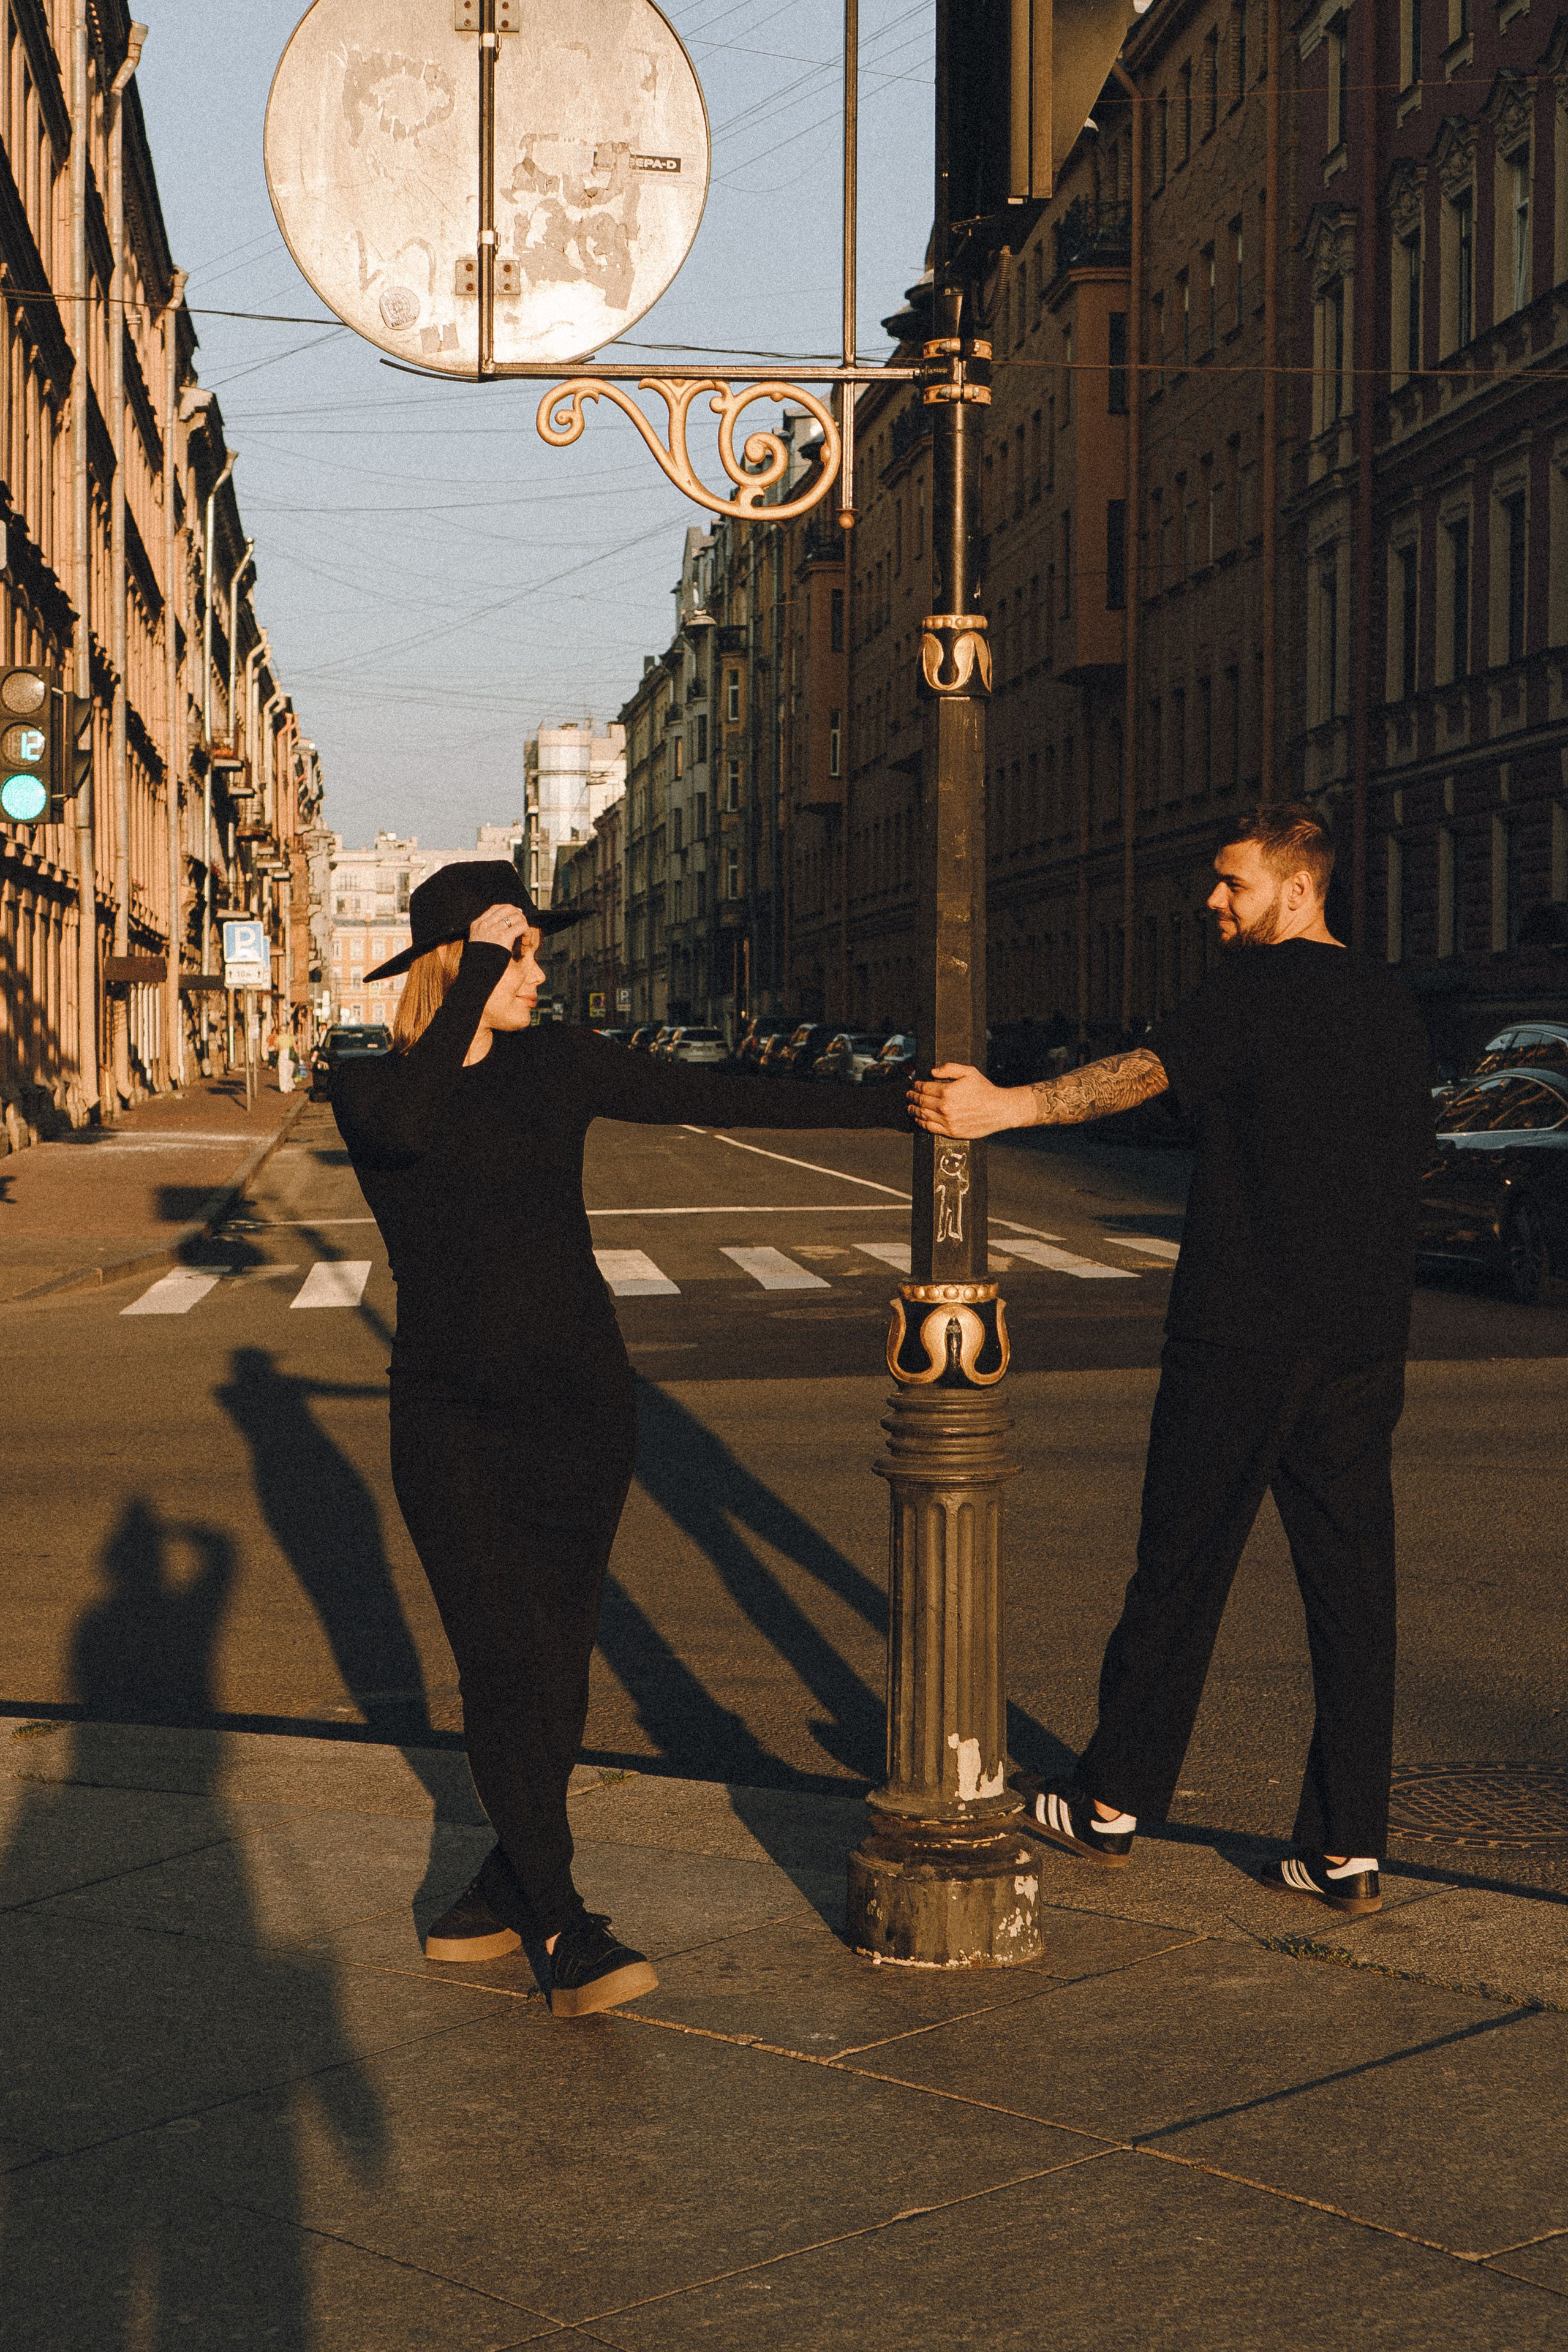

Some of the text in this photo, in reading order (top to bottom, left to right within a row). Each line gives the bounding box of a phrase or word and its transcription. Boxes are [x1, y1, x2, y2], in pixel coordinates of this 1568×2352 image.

[391, 314, 417, 328] ENDLESS
[21, 731, 45, 761] 12
[235, 926, 255, 955] P
